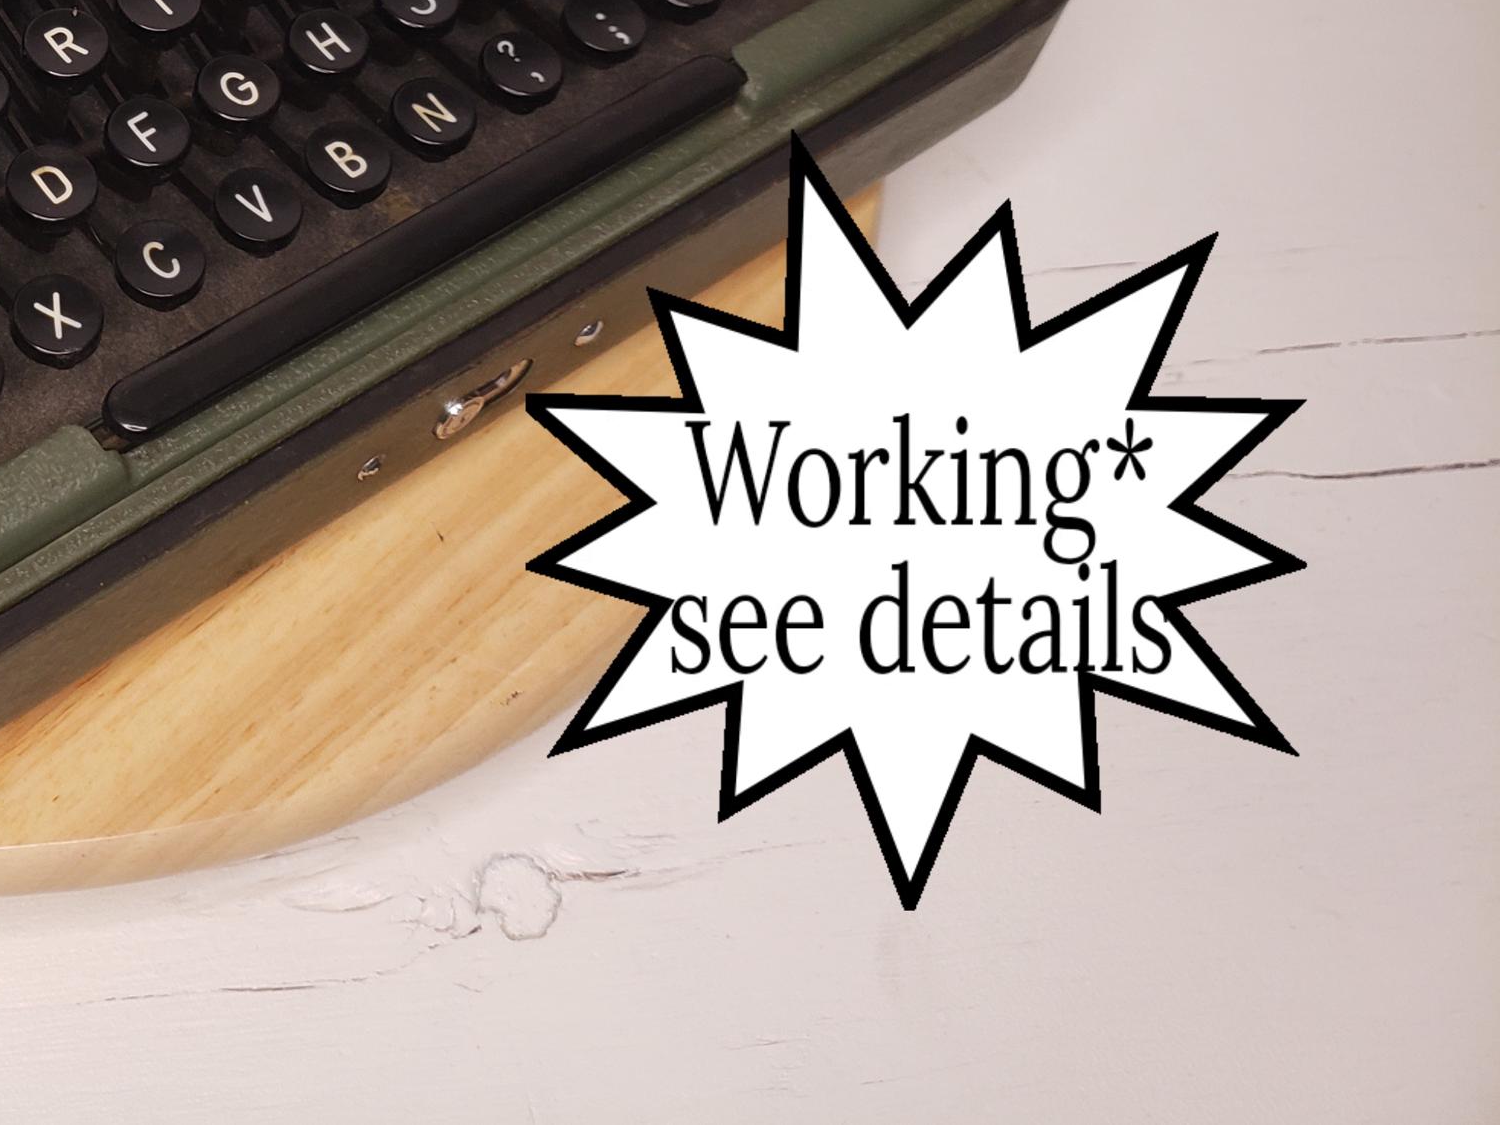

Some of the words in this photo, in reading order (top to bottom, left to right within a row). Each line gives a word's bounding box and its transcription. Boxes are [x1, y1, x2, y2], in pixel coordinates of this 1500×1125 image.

[43, 26, 89, 64] R
[305, 21, 352, 61] H
[496, 40, 521, 63] ?
[219, 71, 259, 106] G
[126, 111, 157, 153] F
[411, 92, 458, 133] N
[324, 140, 368, 179] B
[30, 165, 74, 205] D
[234, 184, 274, 223] V
[142, 241, 181, 279] C
[33, 291, 83, 340] X
